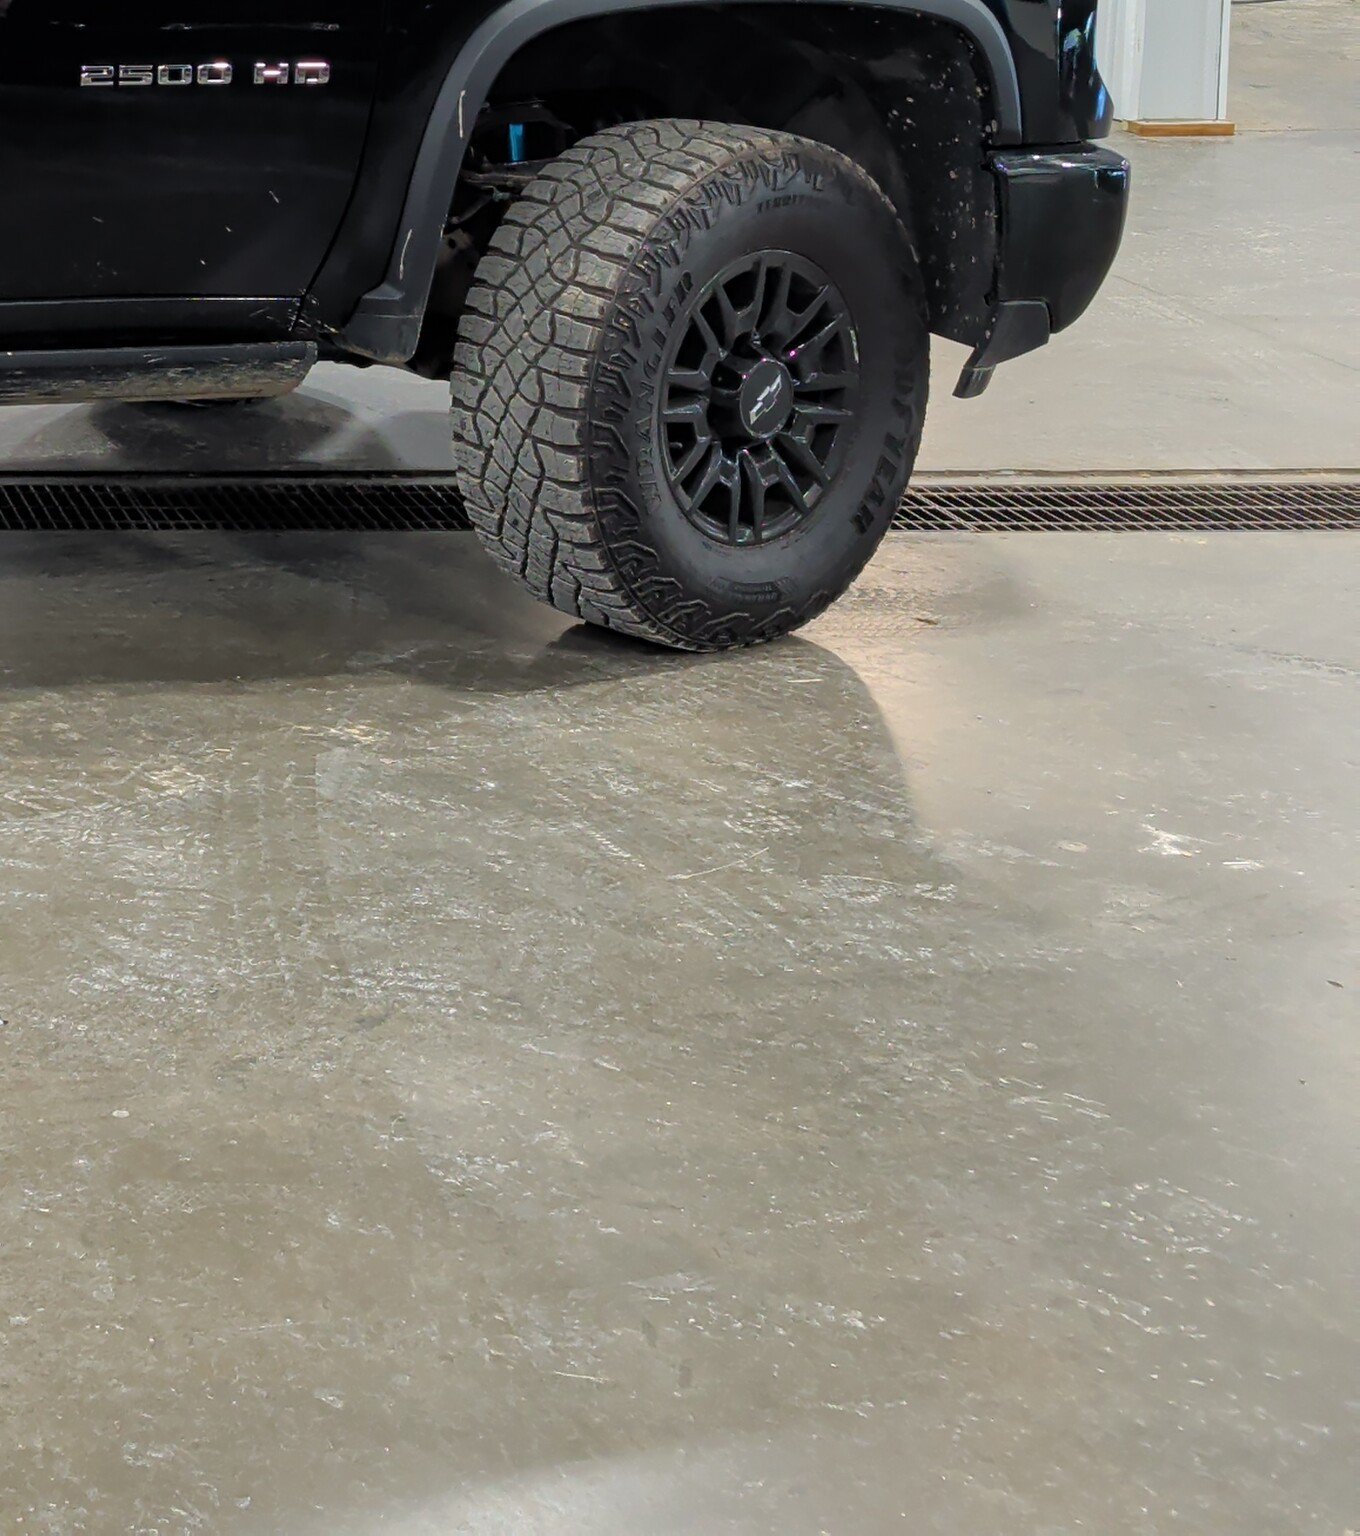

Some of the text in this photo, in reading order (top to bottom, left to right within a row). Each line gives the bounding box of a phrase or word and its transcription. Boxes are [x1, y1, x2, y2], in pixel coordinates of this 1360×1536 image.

[80, 61, 331, 87] 2500 HD
[635, 270, 693, 515] WRANGLER
